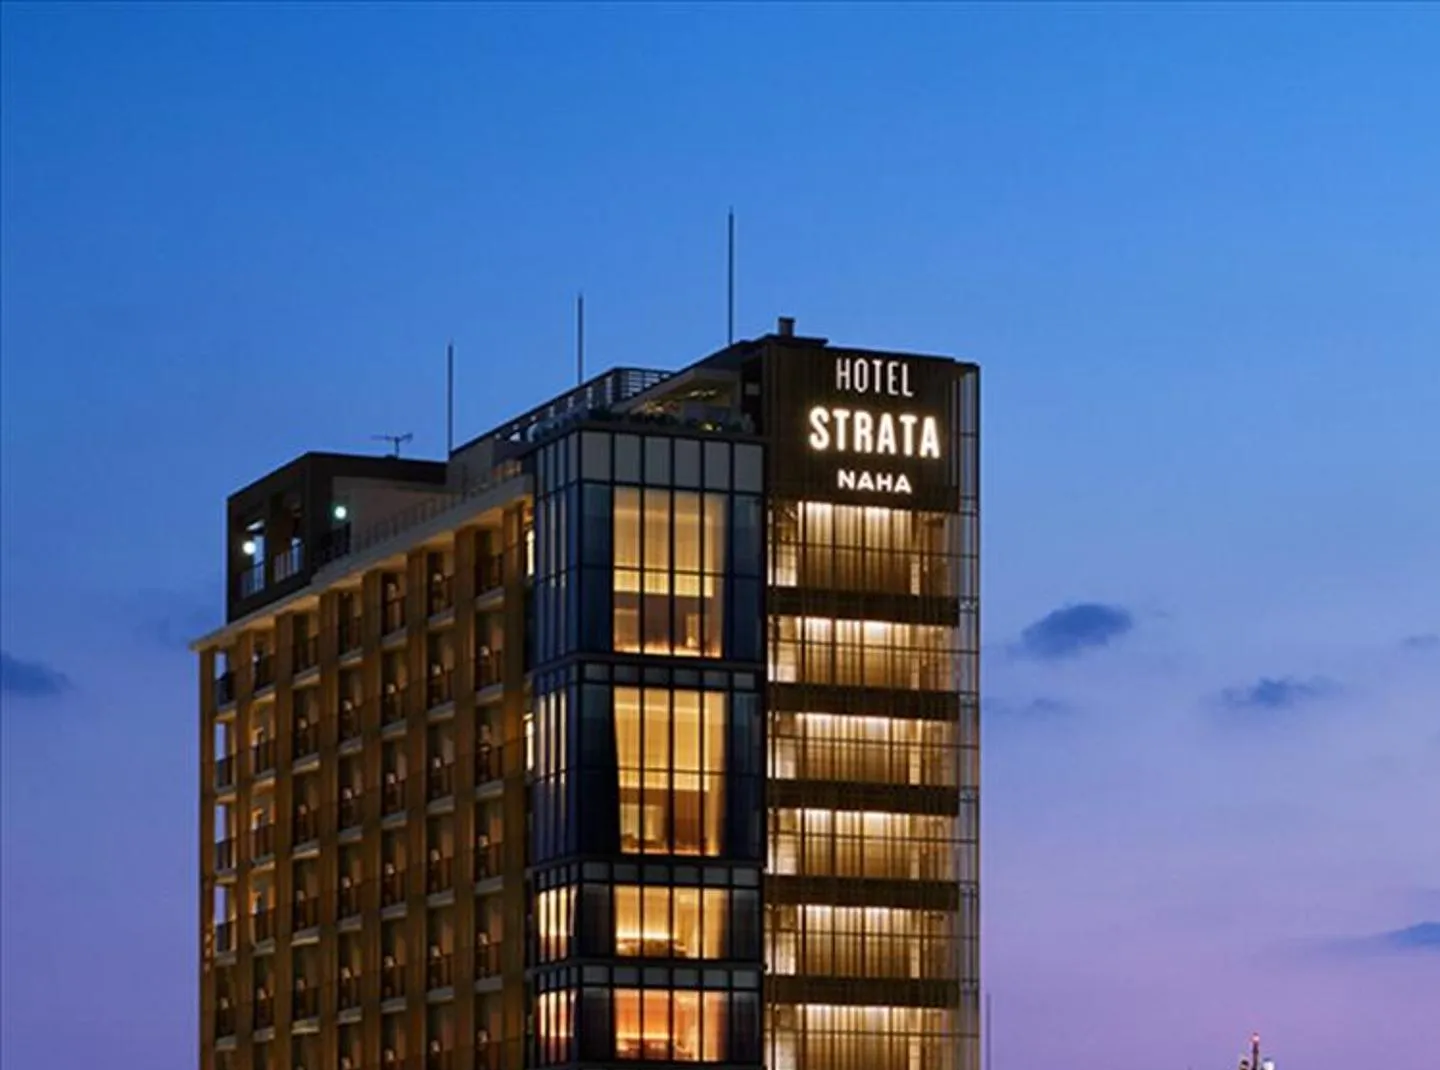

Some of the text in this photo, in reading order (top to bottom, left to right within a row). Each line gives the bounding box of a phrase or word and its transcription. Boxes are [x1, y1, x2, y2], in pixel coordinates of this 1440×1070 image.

[836, 358, 913, 396] HOTEL
[809, 406, 940, 458] STRATA
[837, 469, 912, 494] NAHA
